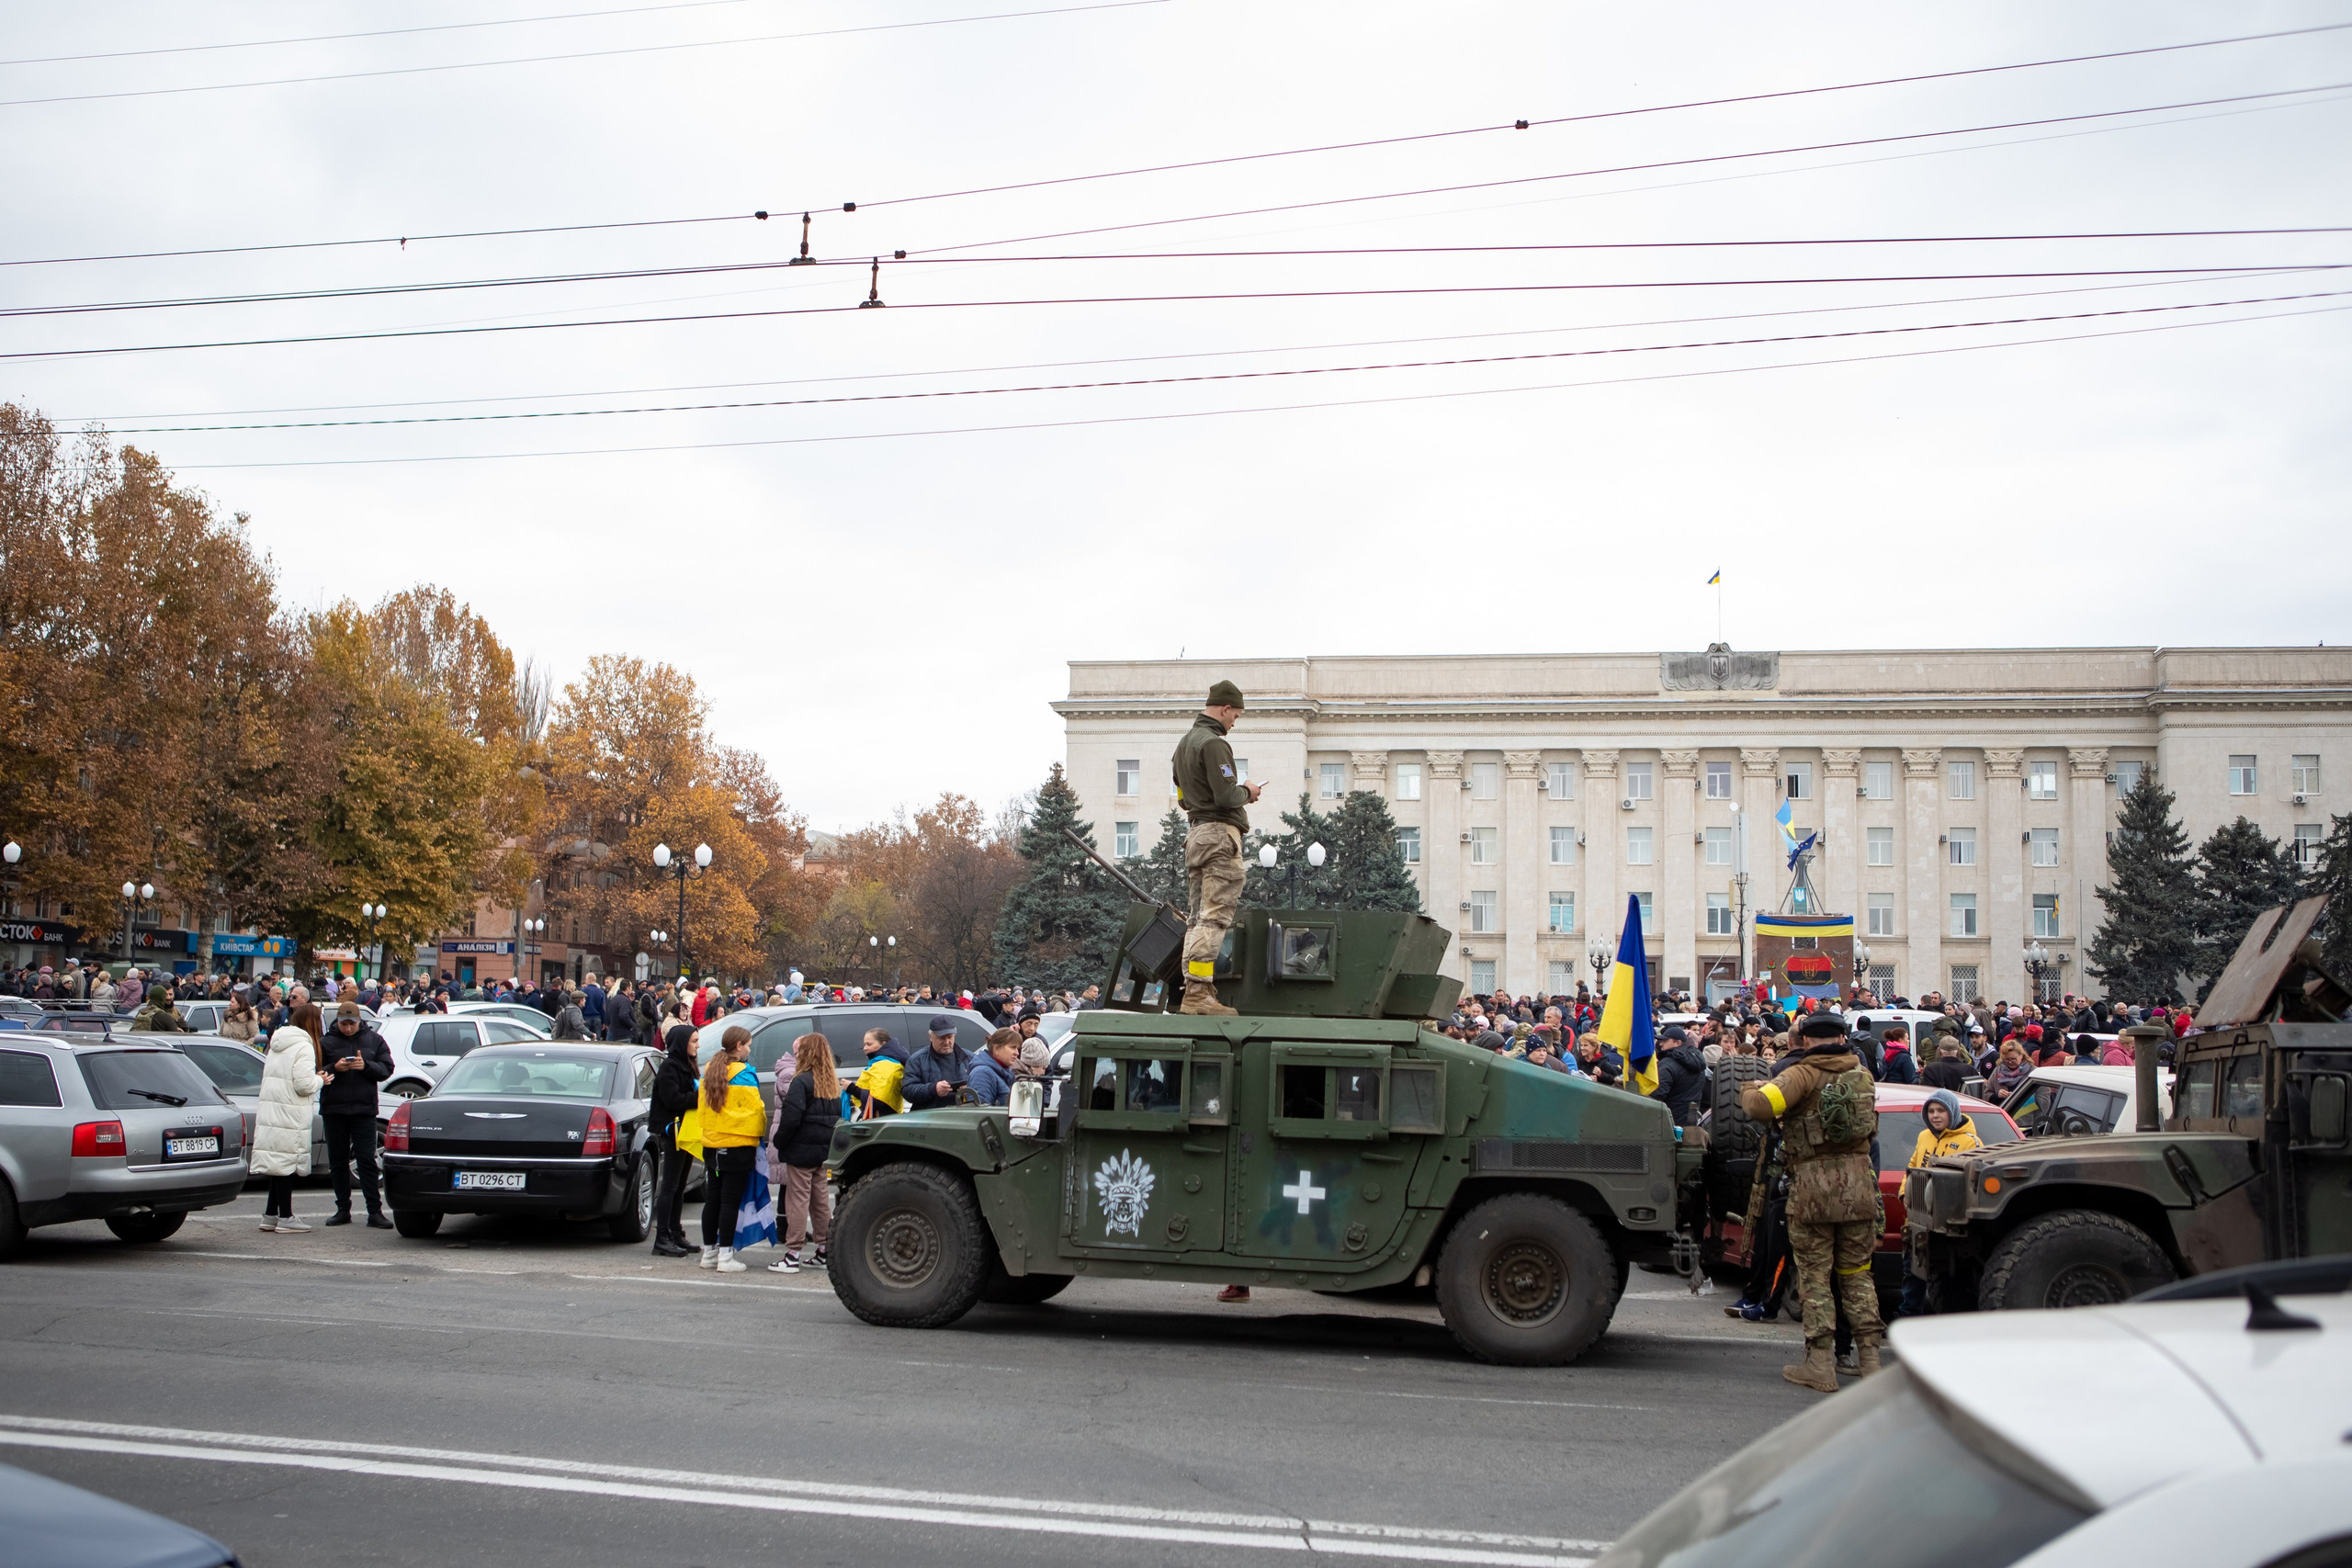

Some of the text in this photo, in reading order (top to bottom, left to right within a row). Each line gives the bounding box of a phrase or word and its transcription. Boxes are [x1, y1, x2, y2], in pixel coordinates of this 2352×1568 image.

[44, 932, 63, 942] БАНК
[153, 939, 171, 948] BANK
[457, 943, 495, 952] АНАЛІЗИ
[172, 1138, 216, 1153] BT 8819 CP
[461, 1174, 523, 1186] BT 0296 CT
